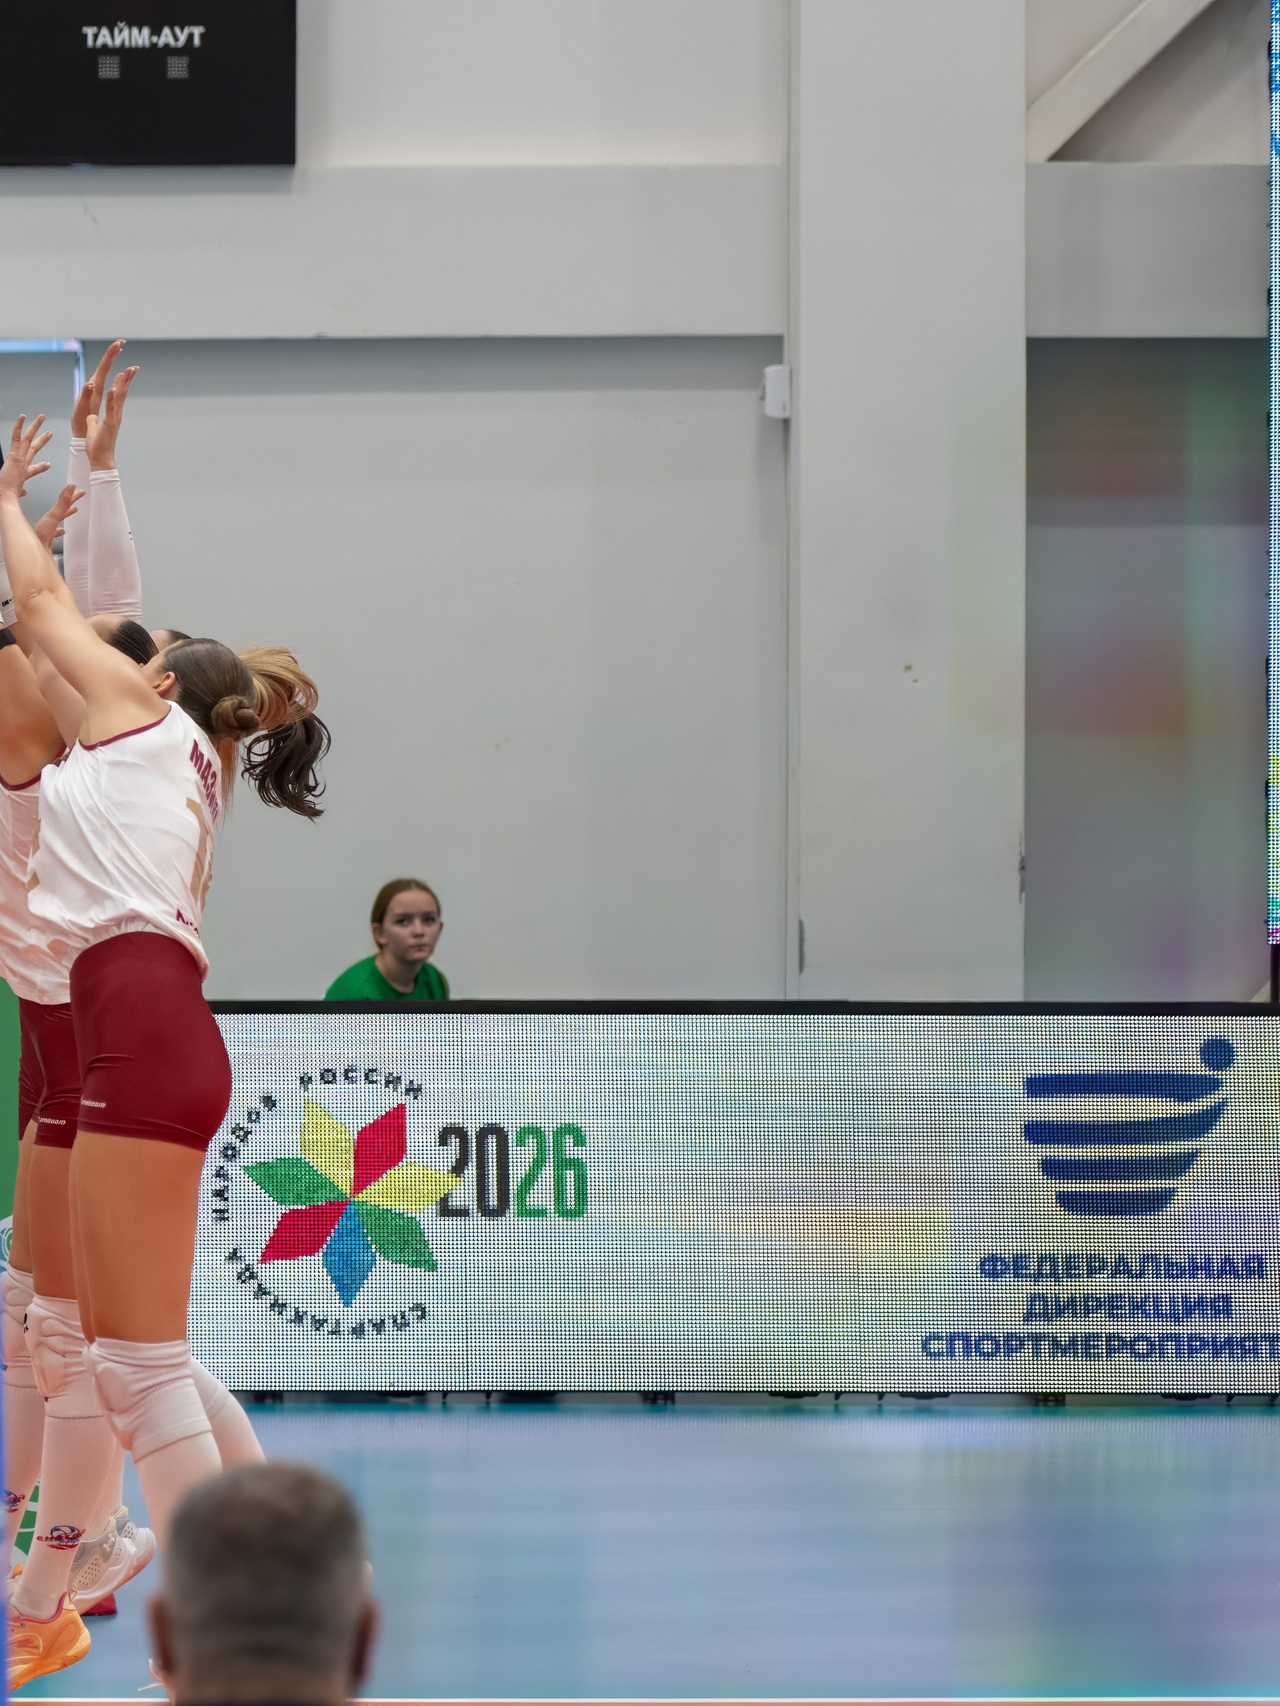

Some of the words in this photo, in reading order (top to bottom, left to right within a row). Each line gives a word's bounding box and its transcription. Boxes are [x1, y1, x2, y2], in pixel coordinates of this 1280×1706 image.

[81, 20, 206, 49] ТАЙМ-АУТ
[211, 1094, 278, 1222] НАРОДОВ
[299, 1066, 424, 1100] РОССИИ
[437, 1122, 589, 1219] 2026
[979, 1253, 1266, 1283] ФЕДЕРАЛЬНАЯ
[1023, 1293, 1233, 1324] ДИРЕКЦИЯ
